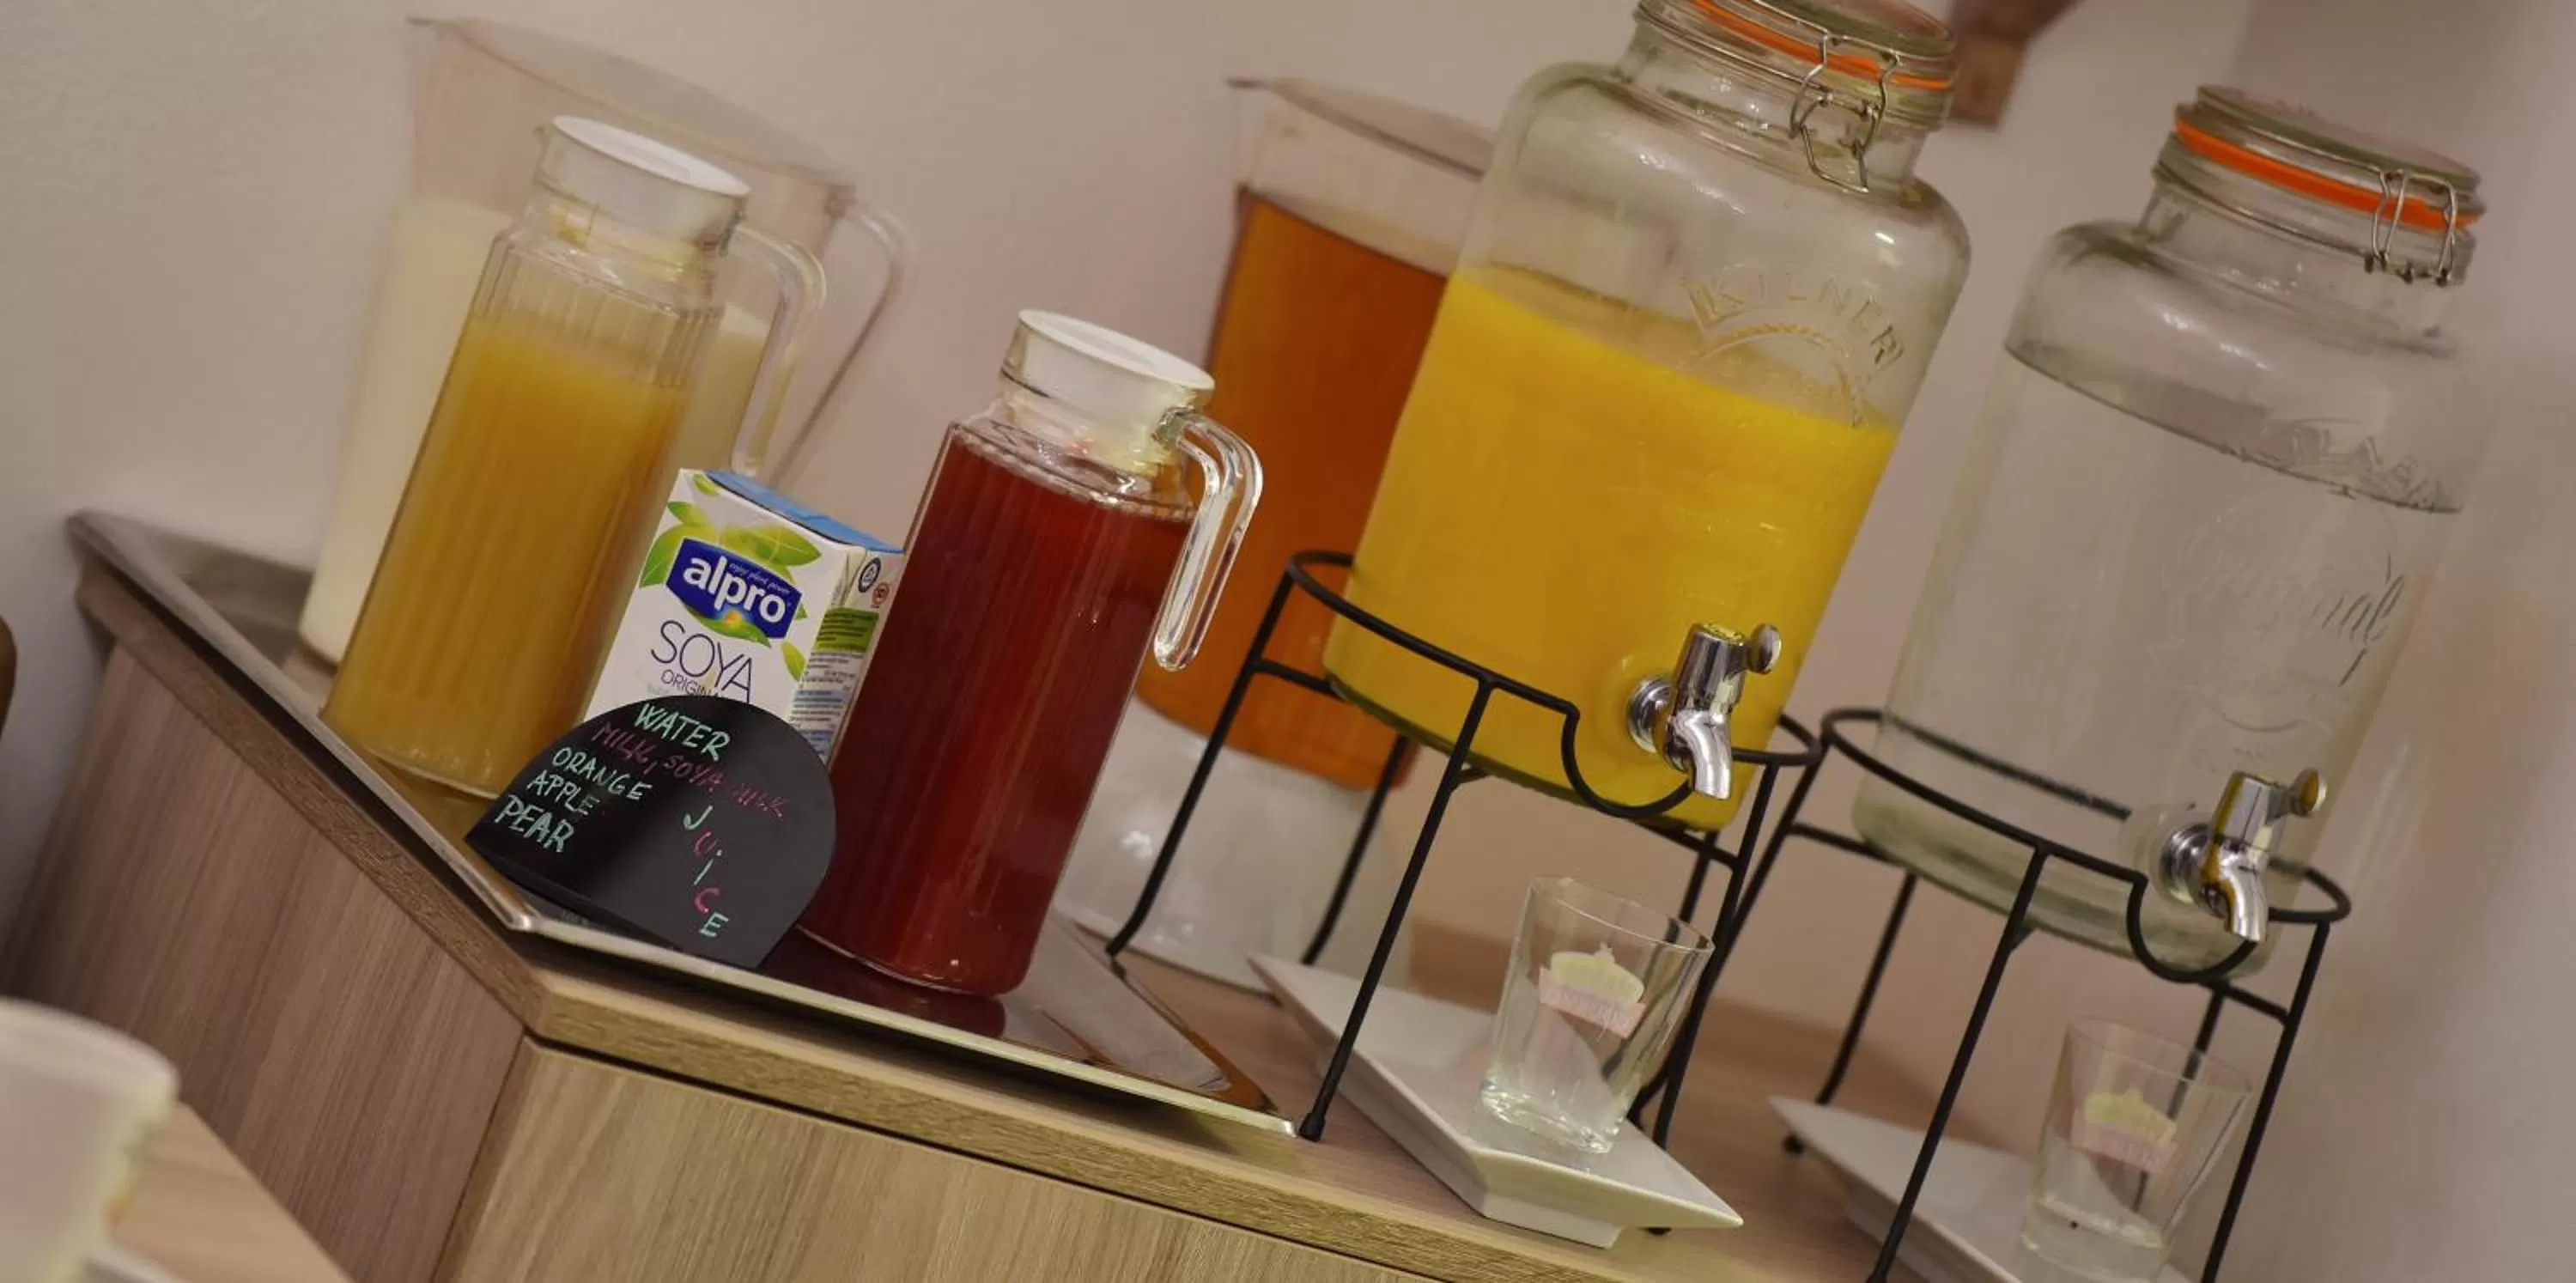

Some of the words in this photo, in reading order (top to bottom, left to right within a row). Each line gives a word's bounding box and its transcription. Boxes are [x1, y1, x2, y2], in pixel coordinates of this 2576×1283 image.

[683, 555, 786, 623] alpro
[650, 619, 752, 703] SOYA
[660, 669, 719, 696] ORIGIN
[634, 702, 731, 762] WATER
[526, 769, 601, 816] APPLE
[552, 746, 653, 800] ORANGE
[662, 755, 724, 792] SOYA
[494, 794, 575, 853] PEAR
